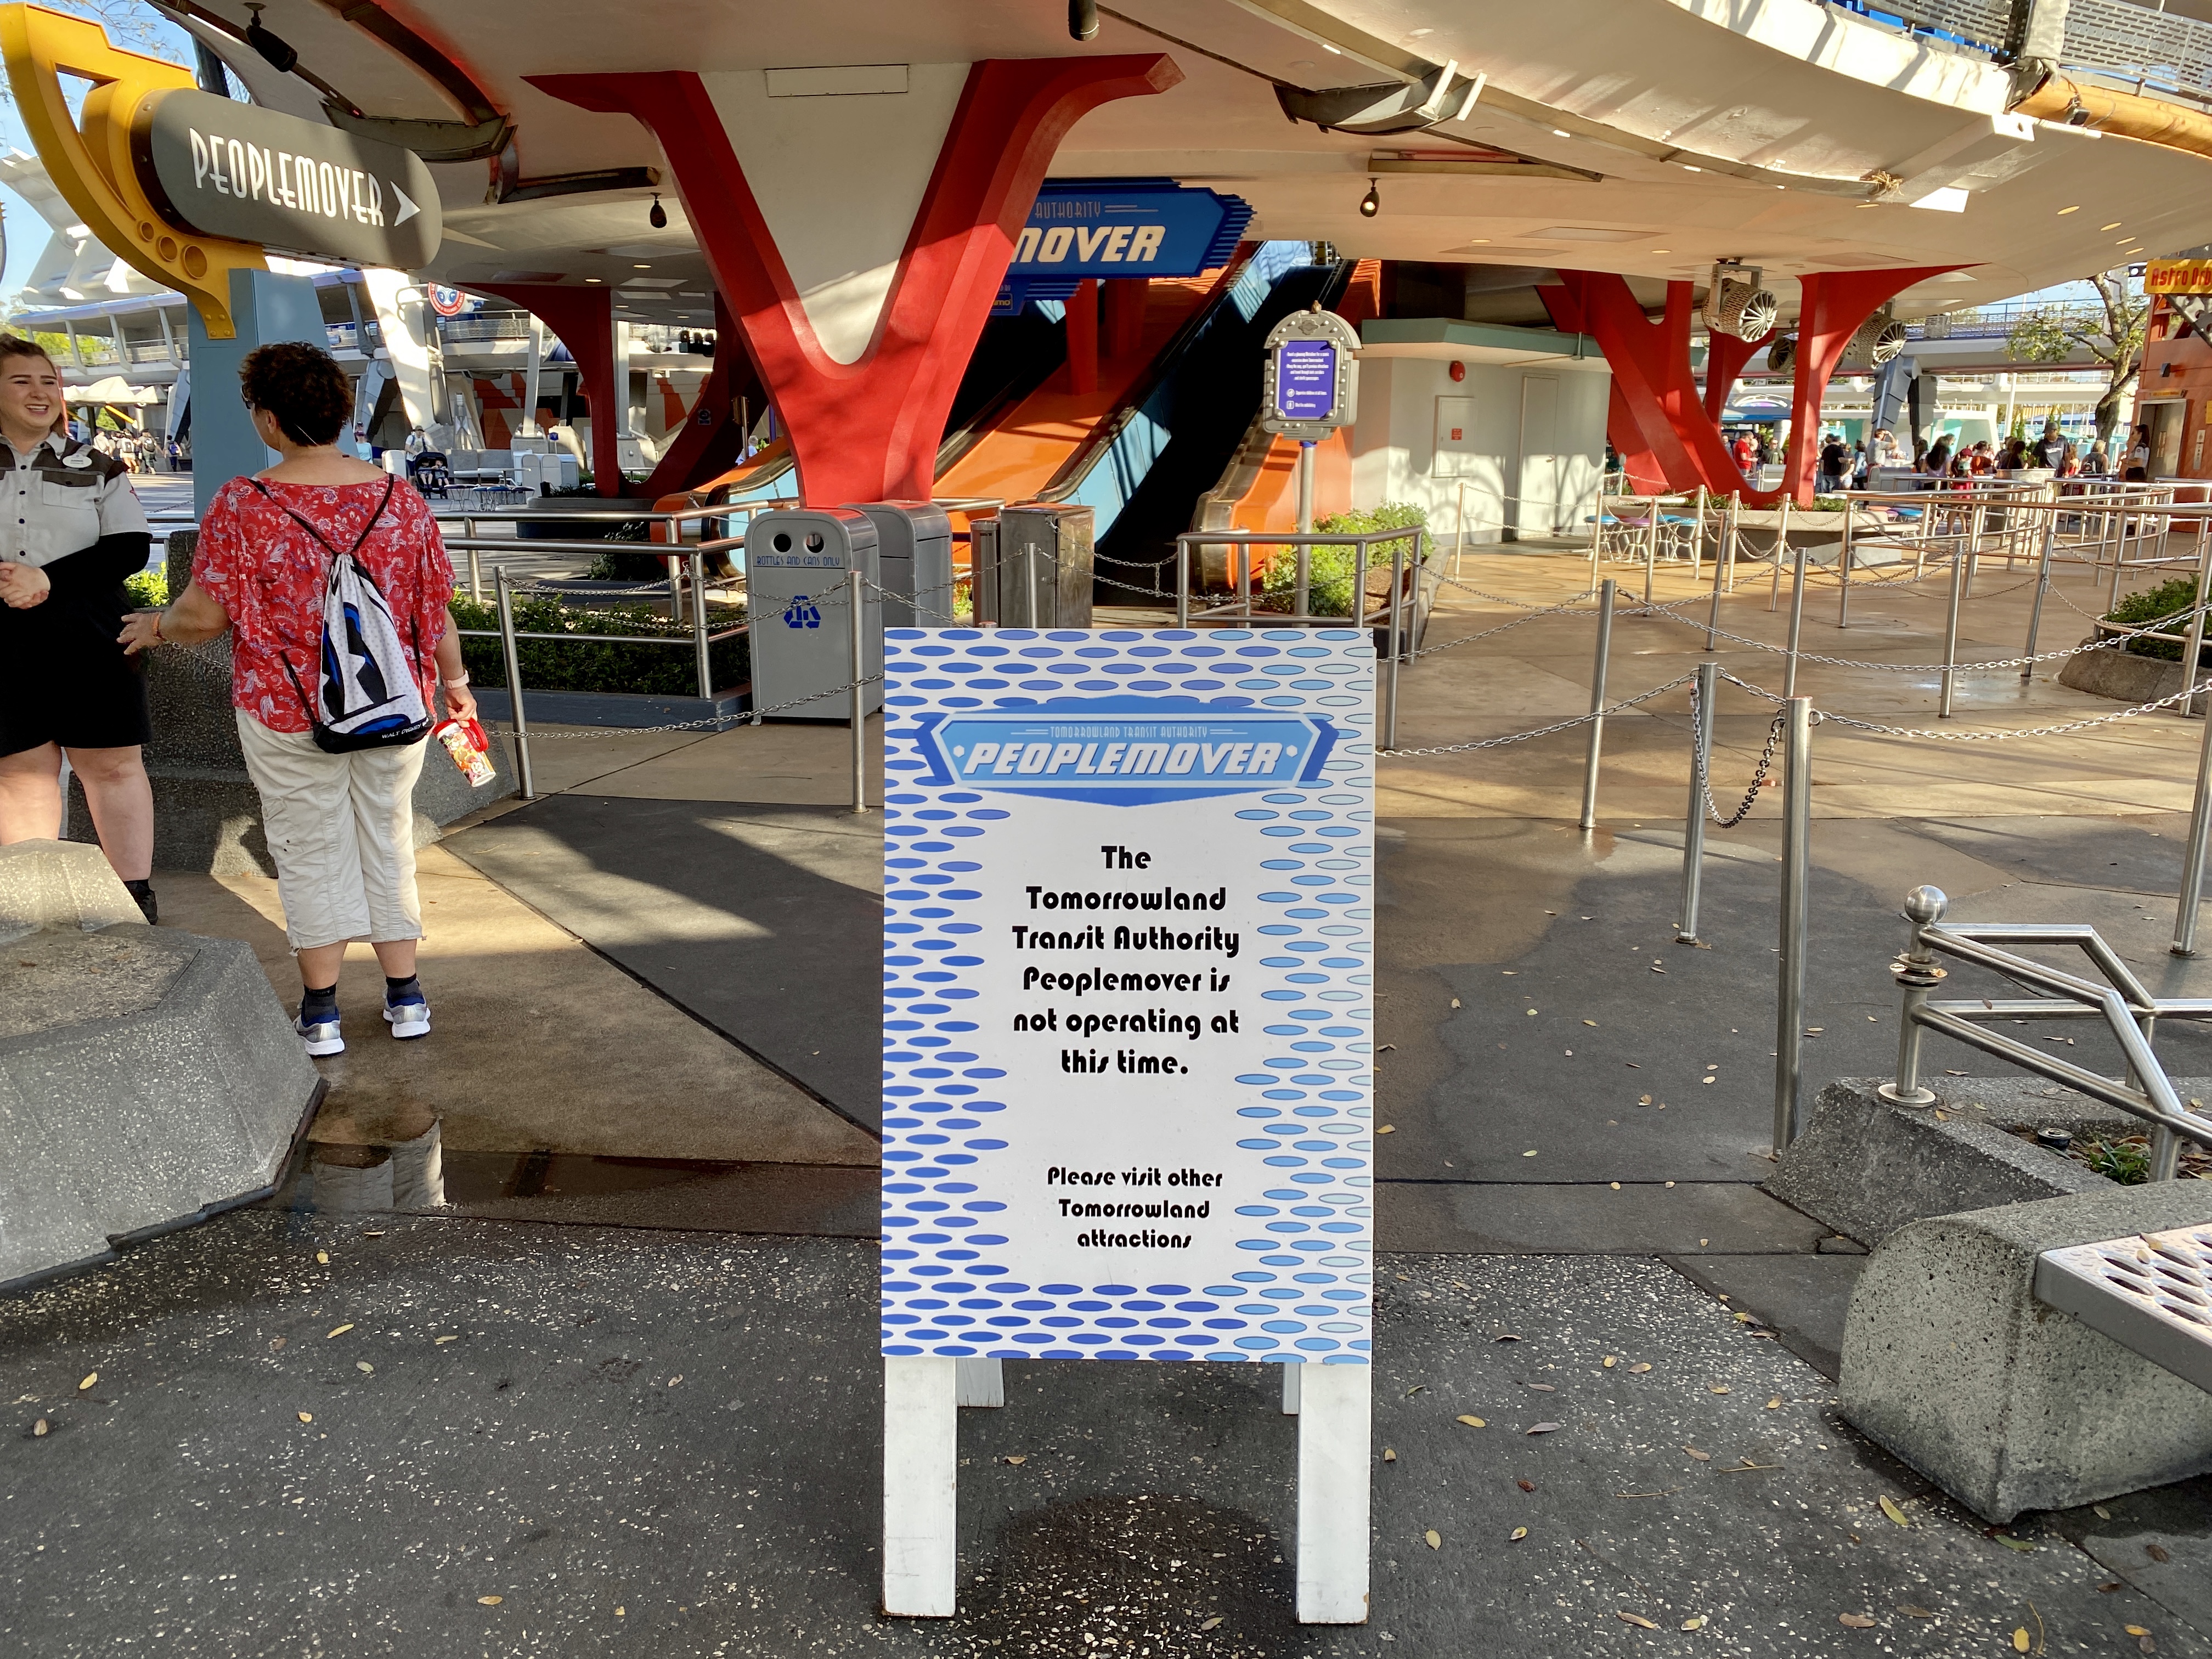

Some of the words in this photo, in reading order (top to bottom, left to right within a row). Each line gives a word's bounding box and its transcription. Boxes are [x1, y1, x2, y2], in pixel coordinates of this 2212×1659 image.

[189, 127, 385, 227] PEOPLEMOVER
[1035, 201, 1101, 218] AUTHORITY
[2151, 267, 2189, 286] Astro
[757, 556, 784, 566] BOTTLES
[787, 556, 800, 565] AND
[803, 556, 820, 566] CANS
[823, 557, 840, 566] ONLY
[1050, 726, 1120, 738] TOMORROWLAND
[1123, 726, 1158, 738] TRANSIT
[1160, 726, 1207, 738] AUTHORITY
[963, 742, 1284, 775] PEOPLEMOVER
[1102, 846, 1151, 869] The
[1026, 886, 1226, 911] Tomorrowland
[1012, 925, 1104, 950] Transit
[1114, 926, 1239, 958] Authority
[1024, 967, 1201, 996] Peoplemover
[1211, 967, 1230, 992] is
[1014, 1008, 1057, 1032] not
[1066, 1008, 1201, 1040] operating
[1211, 1010, 1239, 1034] at
[1062, 1049, 1109, 1074] this
[1118, 1049, 1188, 1074] time.
[1048, 1167, 1115, 1186] Please
[1121, 1167, 1161, 1186] visit
[1168, 1169, 1223, 1187] other
[1059, 1199, 1210, 1218] Tomorrowland
[1077, 1229, 1192, 1249] attractions
